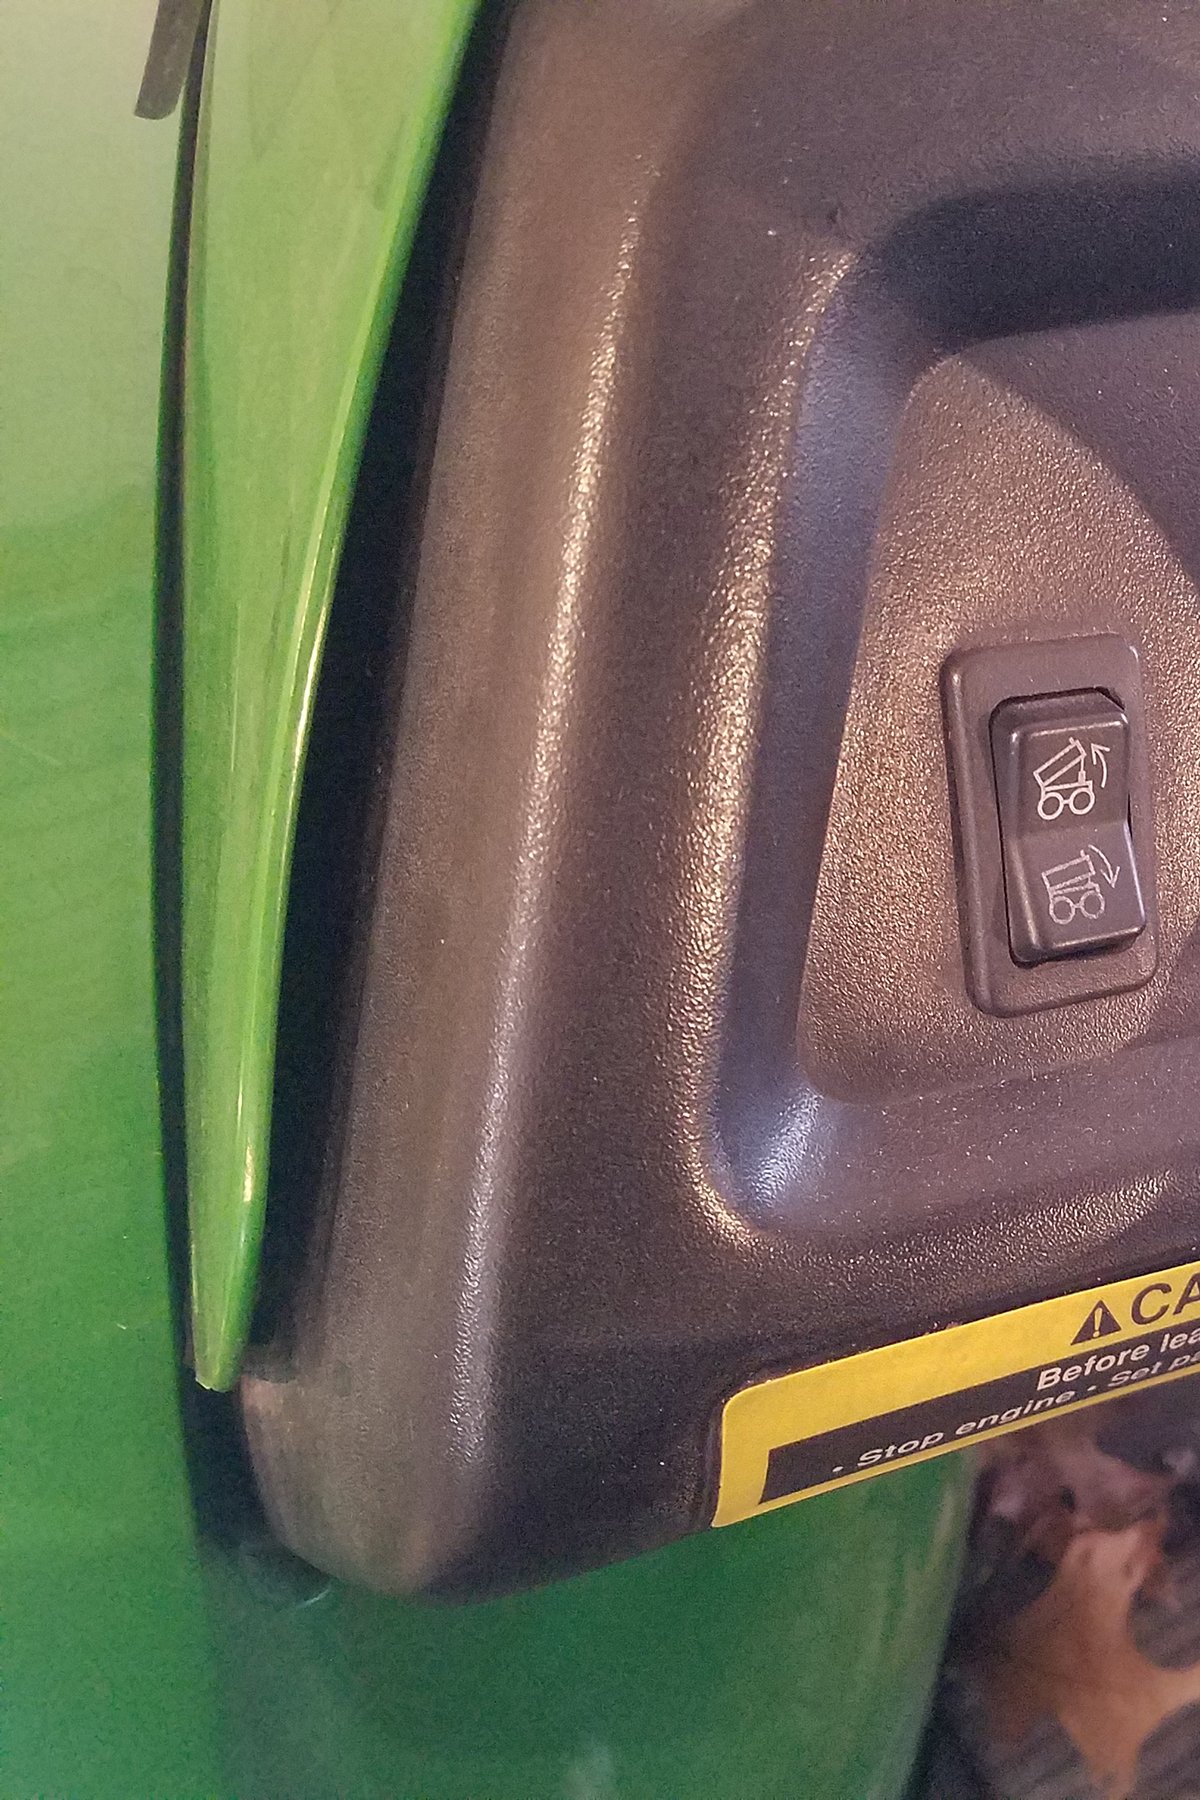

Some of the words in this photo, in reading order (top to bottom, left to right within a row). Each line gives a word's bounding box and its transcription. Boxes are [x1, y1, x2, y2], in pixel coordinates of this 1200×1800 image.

[1036, 1344, 1149, 1391] Before
[857, 1431, 944, 1467] Stop
[955, 1389, 1075, 1436] engine
[1107, 1359, 1159, 1388] Set
